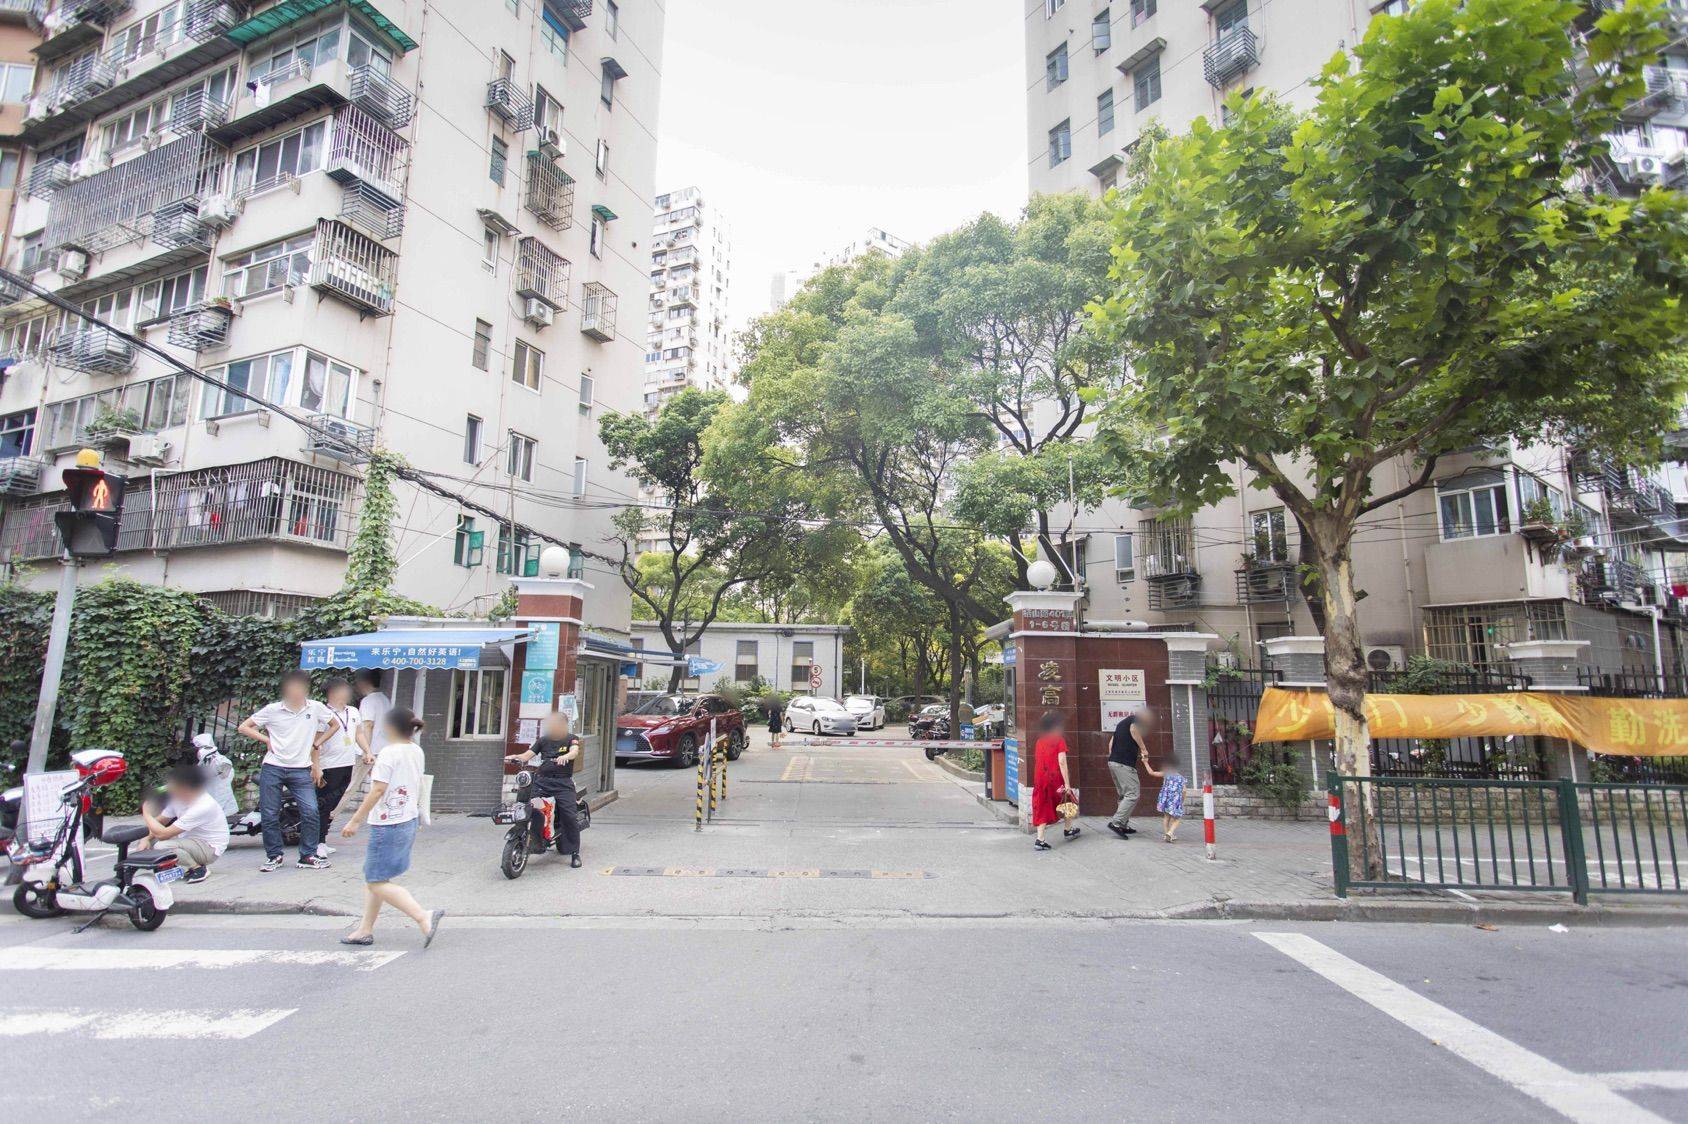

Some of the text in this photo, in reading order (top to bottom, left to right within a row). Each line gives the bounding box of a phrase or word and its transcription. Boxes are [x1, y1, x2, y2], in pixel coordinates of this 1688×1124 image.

[391, 657, 447, 665] 400-700-3128
[1105, 674, 1138, 682] 文明小区
